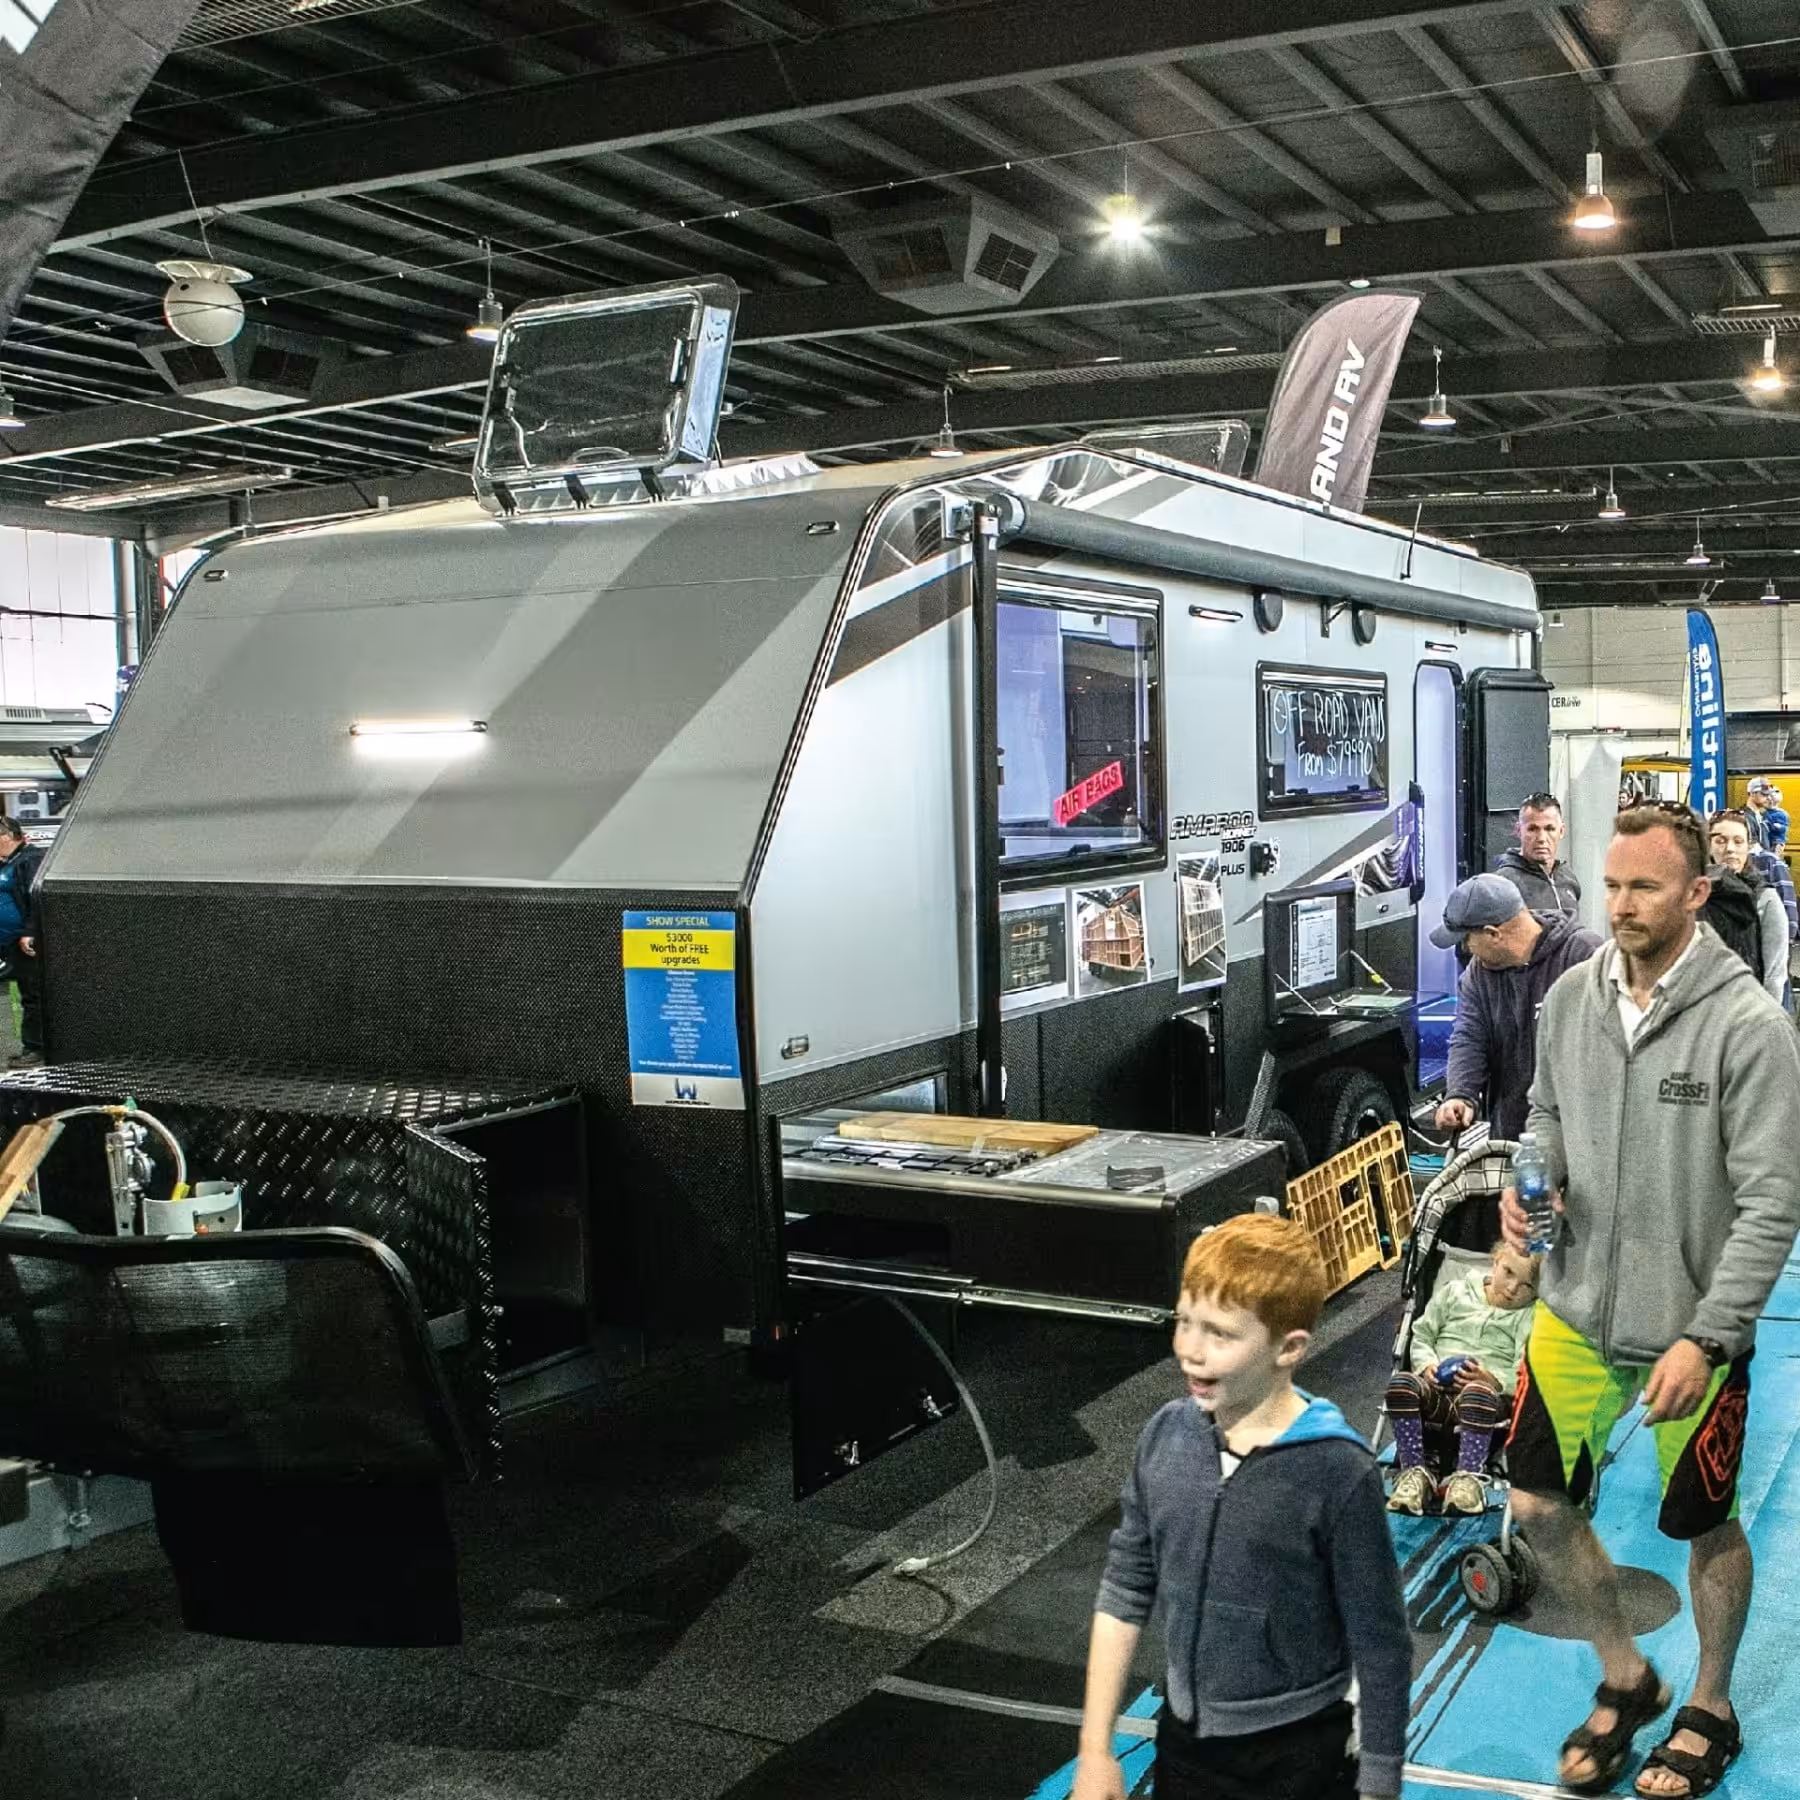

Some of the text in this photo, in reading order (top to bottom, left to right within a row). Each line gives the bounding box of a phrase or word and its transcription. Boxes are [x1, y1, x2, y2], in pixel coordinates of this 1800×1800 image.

[1310, 337, 1365, 503] AND RV
[1273, 690, 1385, 743] OFF ROAD VANS
[1327, 738, 1373, 778] $79990
[1060, 765, 1120, 820] AIR BAGS
[1169, 811, 1254, 840] AMAROO
[1221, 840, 1245, 854] 1906
[1221, 864, 1245, 877] PLUS
[646, 916, 710, 927] SHOW SPECIAL
[666, 932, 693, 943] $3000
[650, 943, 709, 954] Worth of FREE
[661, 955, 701, 967] upgrades
